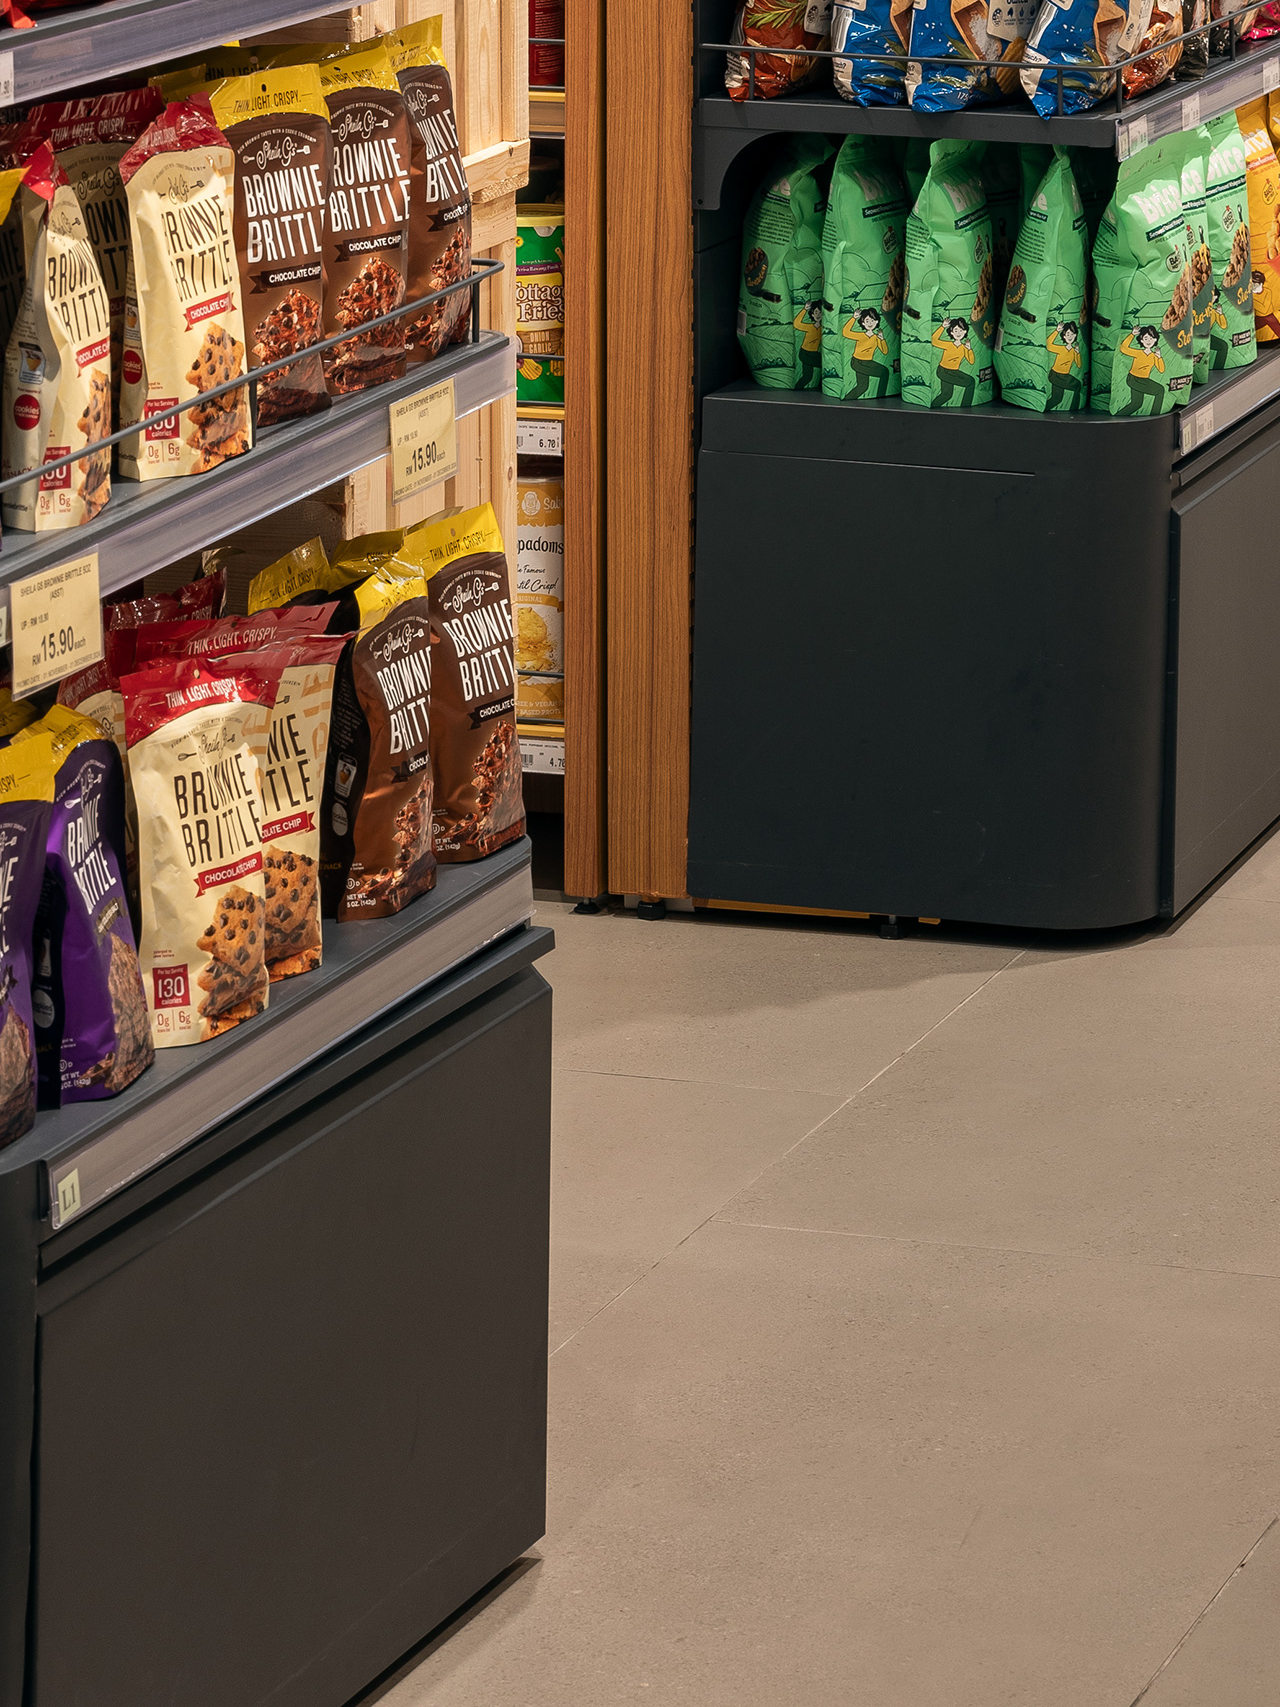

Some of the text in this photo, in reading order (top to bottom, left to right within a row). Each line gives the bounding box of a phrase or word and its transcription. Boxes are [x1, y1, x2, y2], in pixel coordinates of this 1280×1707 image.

[273, 89, 302, 109] CRISPY.
[242, 164, 325, 218] BROWNIE
[329, 179, 411, 233] BRITTLE
[269, 266, 321, 283] CHOCOLATE CHIP
[529, 342, 552, 354] GARLIC
[530, 331, 550, 343] ONION
[539, 439, 556, 448] 6.70
[44, 575, 64, 589] BROWNIE
[65, 568, 82, 581] BRITTLE
[32, 654, 41, 666] RM
[41, 626, 74, 661] 15.90
[165, 676, 241, 709] THIN. LIGHT. CRISPY.
[174, 752, 252, 820] BROWNIE
[181, 799, 263, 868] BRITTLE
[204, 856, 258, 885] CHOCOLATE CHIP
[157, 976, 184, 999] 130
